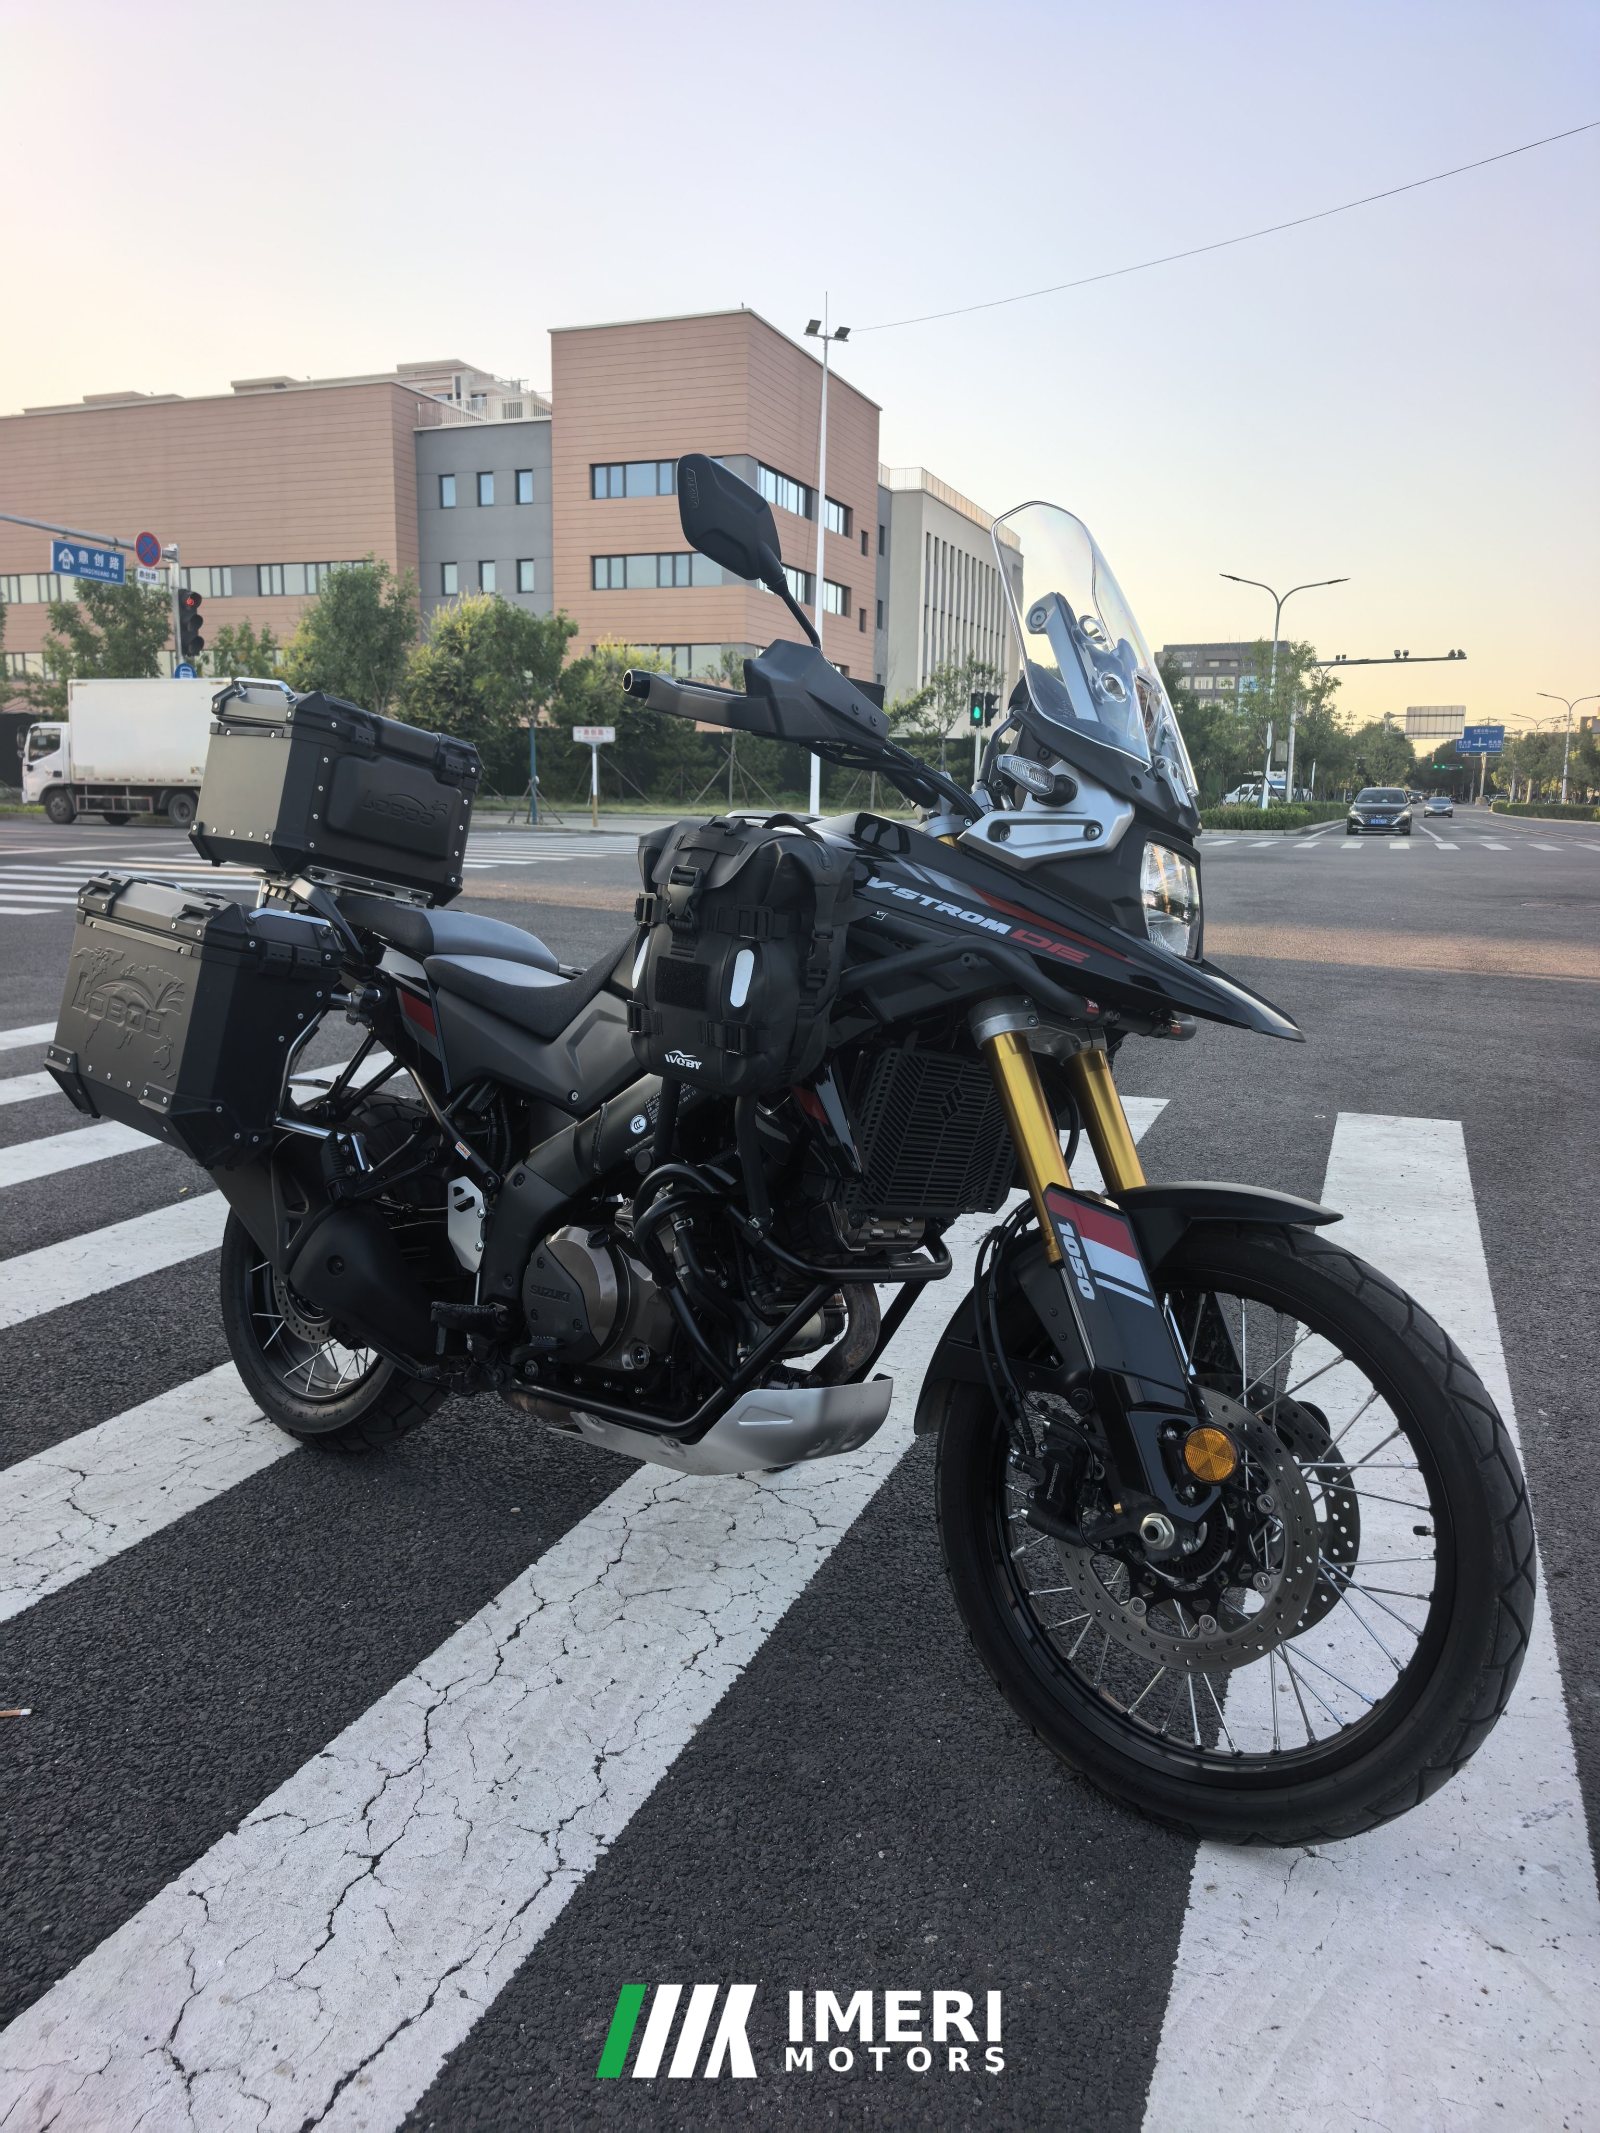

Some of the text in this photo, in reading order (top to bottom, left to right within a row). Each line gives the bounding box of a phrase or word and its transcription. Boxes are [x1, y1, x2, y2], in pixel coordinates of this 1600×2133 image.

[866, 876, 1091, 964] V-STROM DE
[528, 1284, 571, 1303] SUZUKI
[1057, 1222, 1096, 1301] 1050
